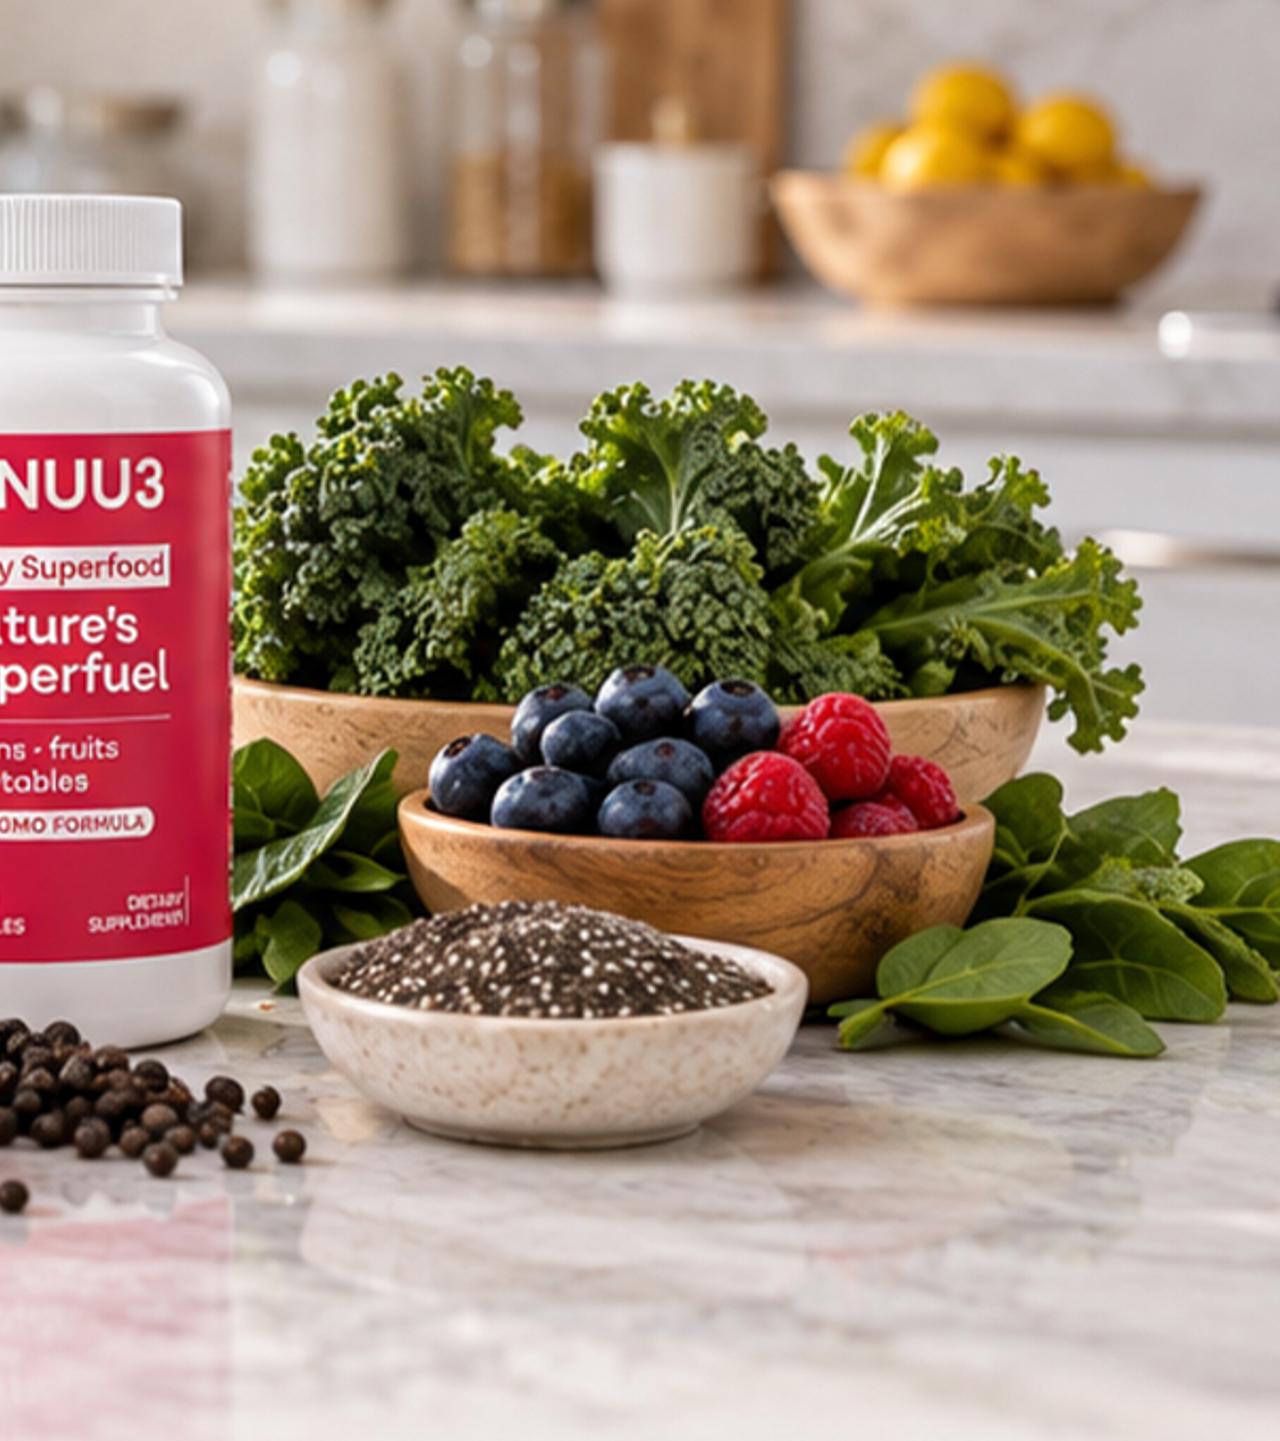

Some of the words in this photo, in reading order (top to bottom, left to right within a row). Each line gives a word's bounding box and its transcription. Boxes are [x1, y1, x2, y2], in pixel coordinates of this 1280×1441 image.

[21, 552, 165, 587] Superfood
[48, 735, 119, 761] fruits
[52, 814, 146, 834] FORMULA
